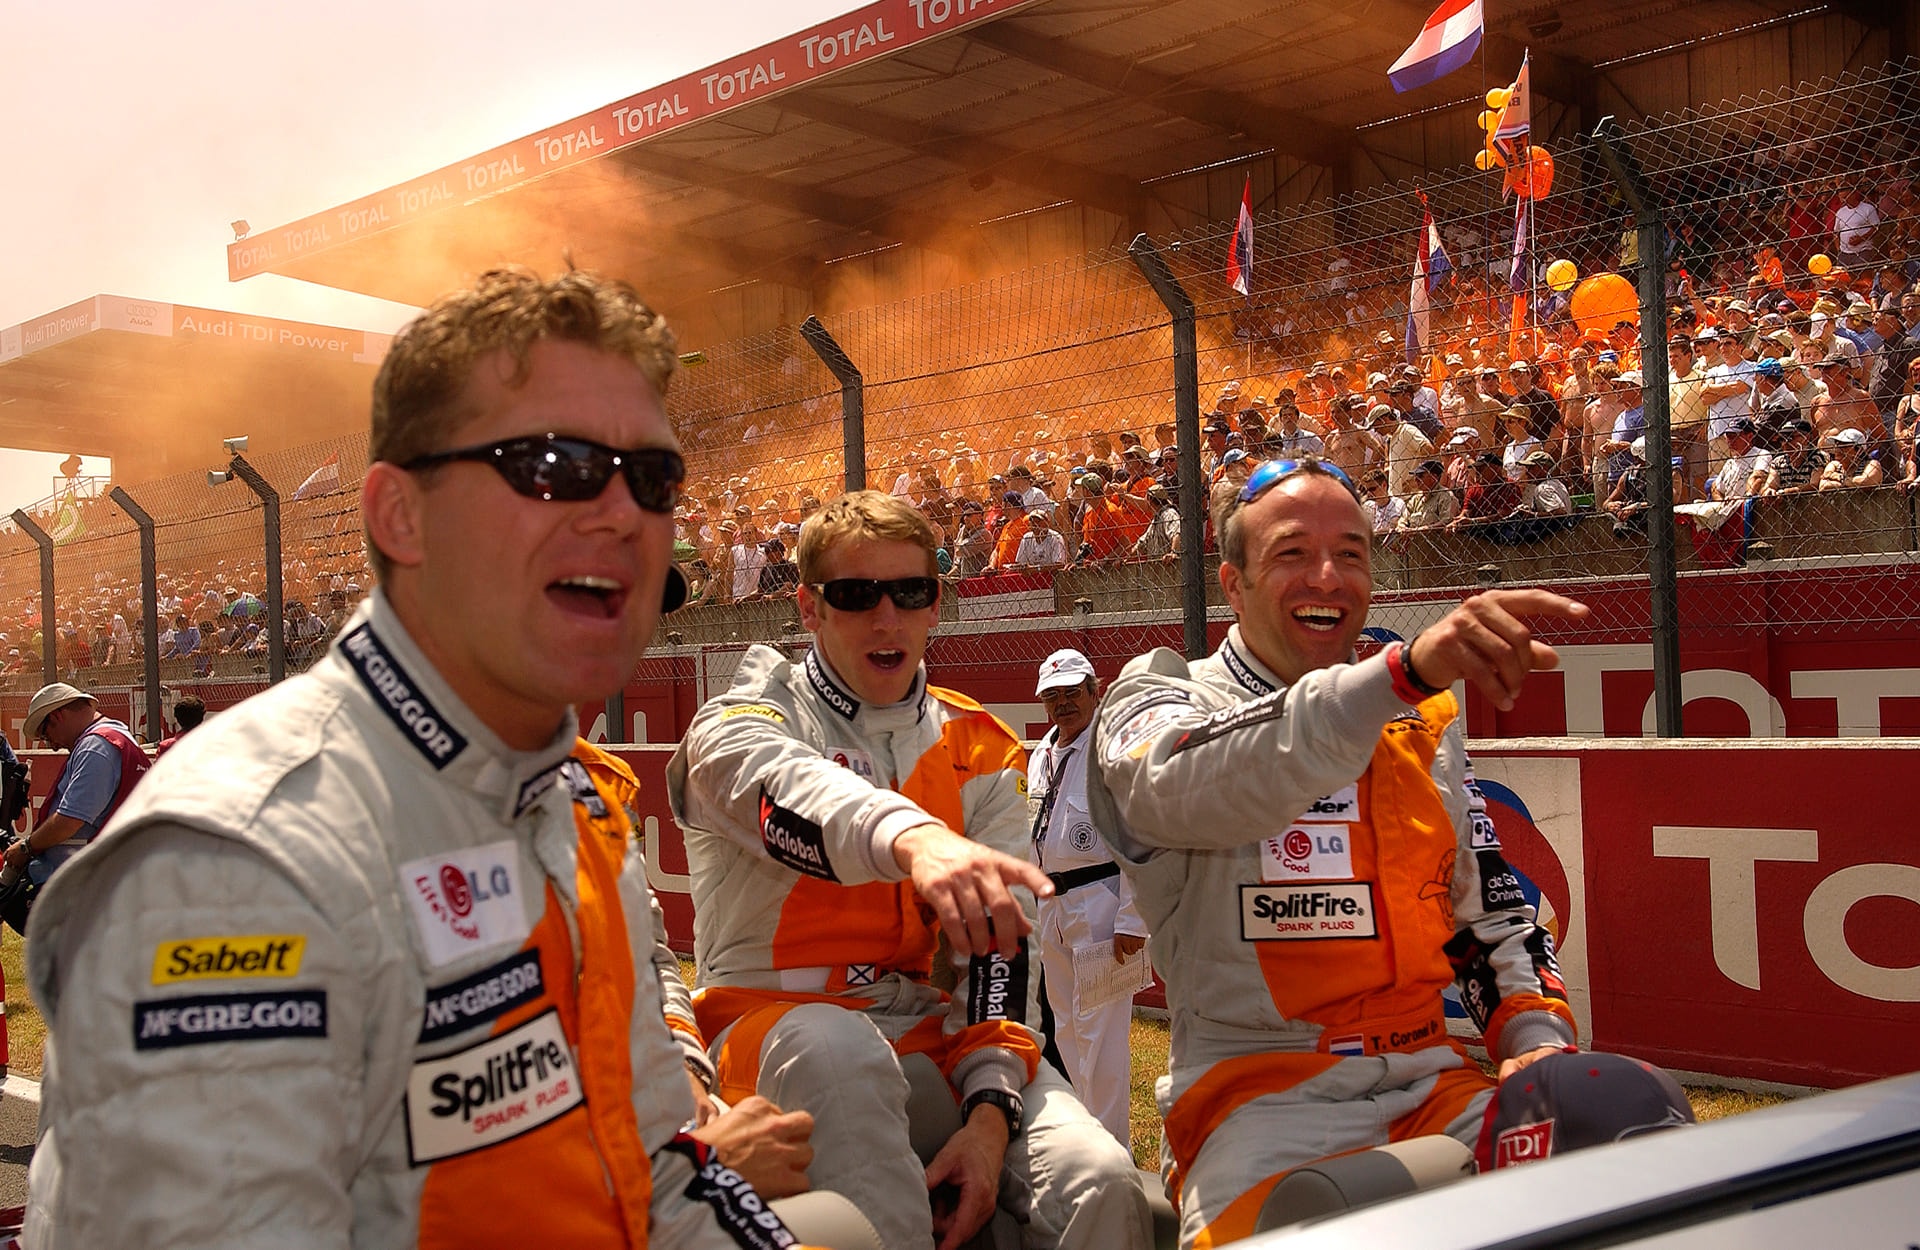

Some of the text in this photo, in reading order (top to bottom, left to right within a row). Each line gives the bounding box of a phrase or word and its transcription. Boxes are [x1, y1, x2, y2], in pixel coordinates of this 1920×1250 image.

[800, 18, 894, 68] TOTAL
[701, 57, 785, 104] TOTAL
[612, 94, 689, 136] TOTAL
[534, 125, 604, 165] TOTAL
[462, 154, 525, 191] TOTAL
[396, 181, 454, 216] TOTAL
[338, 206, 390, 235] TOTAL
[233, 242, 277, 270] TOTAL
[284, 224, 330, 255] TOTAL
[25, 313, 89, 345] Audi TDI Power
[180, 316, 349, 352] Audi TDI Power
[852, 759, 872, 777] LG
[1316, 836, 1344, 854] LG
[469, 864, 511, 902] LG
[1277, 920, 1355, 932] SPARK PLUGS
[167, 941, 293, 976] Sabelt
[140, 1001, 322, 1039] McGREGOR
[473, 1100, 530, 1134] SPARK
[1501, 1132, 1540, 1162] TDI
